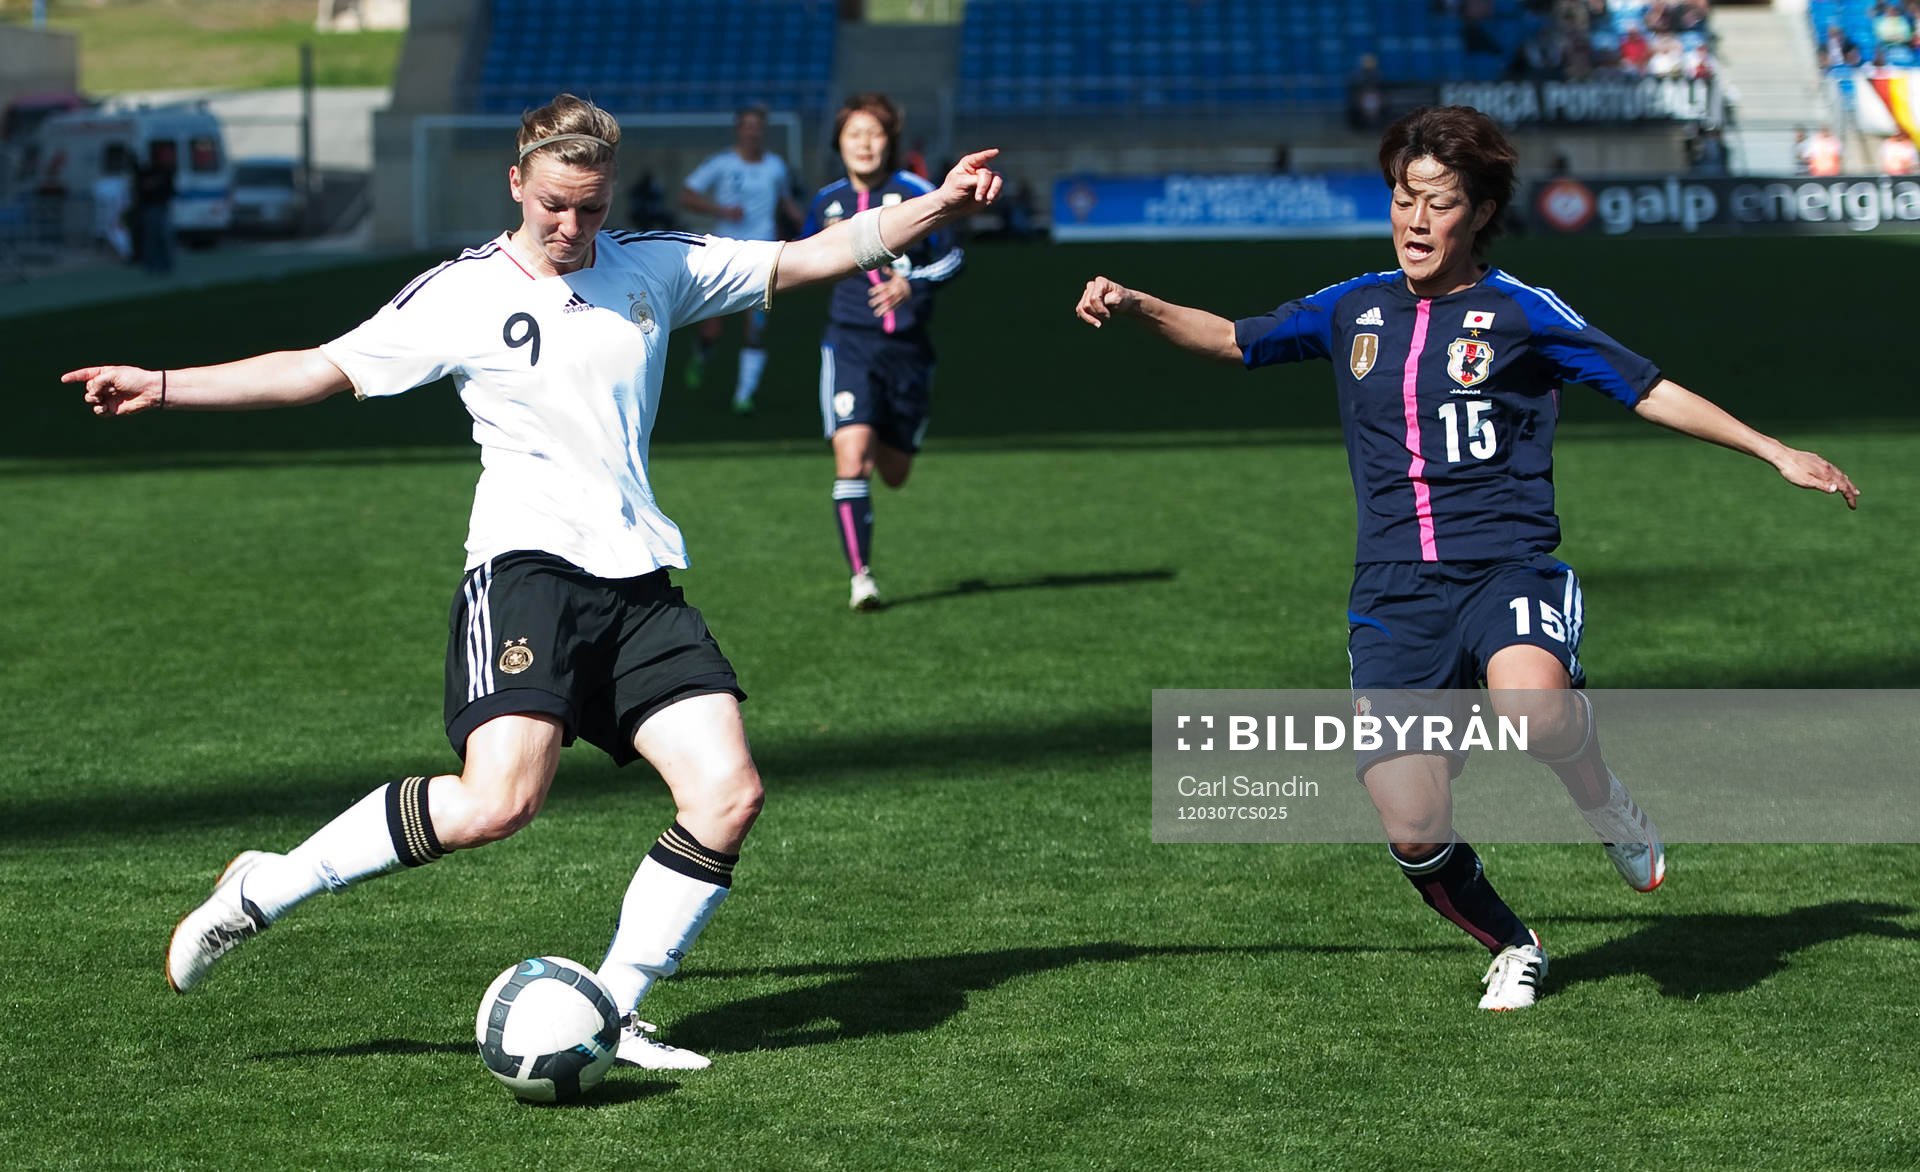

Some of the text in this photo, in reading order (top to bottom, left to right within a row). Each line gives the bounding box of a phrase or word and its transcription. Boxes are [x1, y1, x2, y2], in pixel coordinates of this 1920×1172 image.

[1598, 174, 1920, 235] galp energia
[503, 311, 541, 367] 9
[1438, 400, 1497, 462] 15
[1509, 596, 1567, 643] 15
